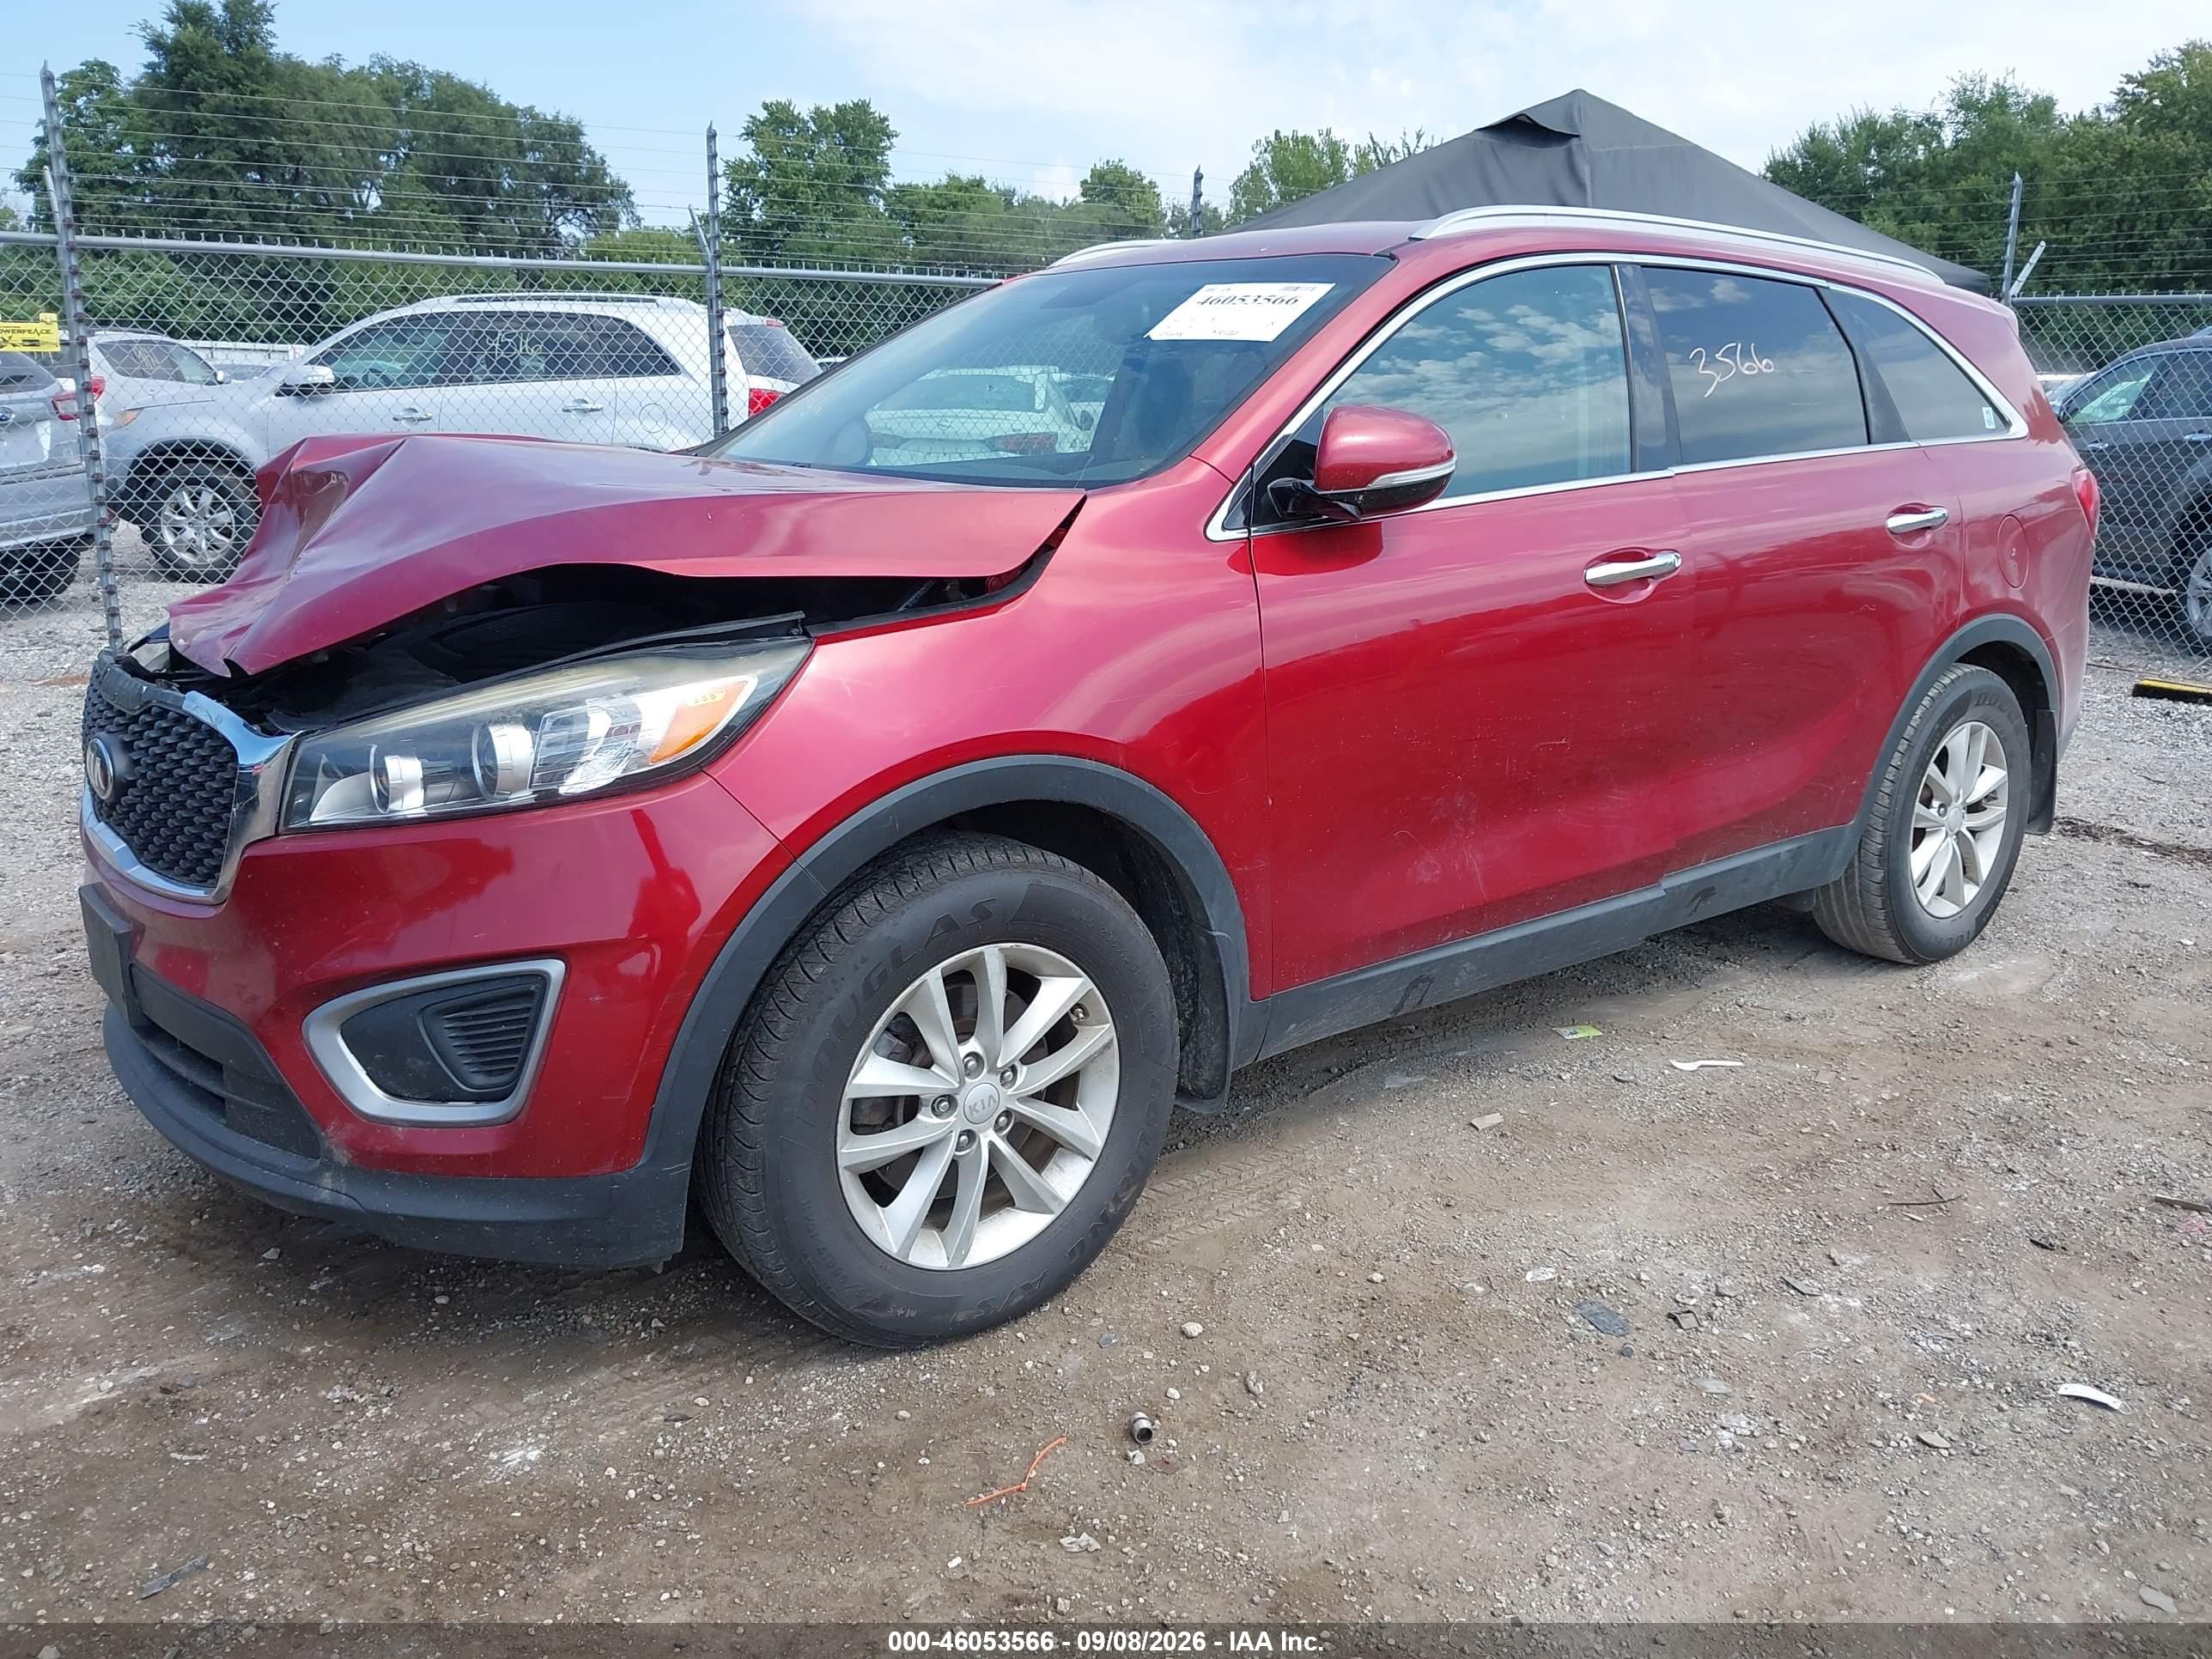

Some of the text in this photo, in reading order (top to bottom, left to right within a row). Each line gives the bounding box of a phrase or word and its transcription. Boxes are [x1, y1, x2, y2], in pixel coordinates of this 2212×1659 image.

[1196, 294, 1300, 307] 46053566
[1688, 343, 1774, 398] 3566
[968, 1093, 997, 1116] KIA
